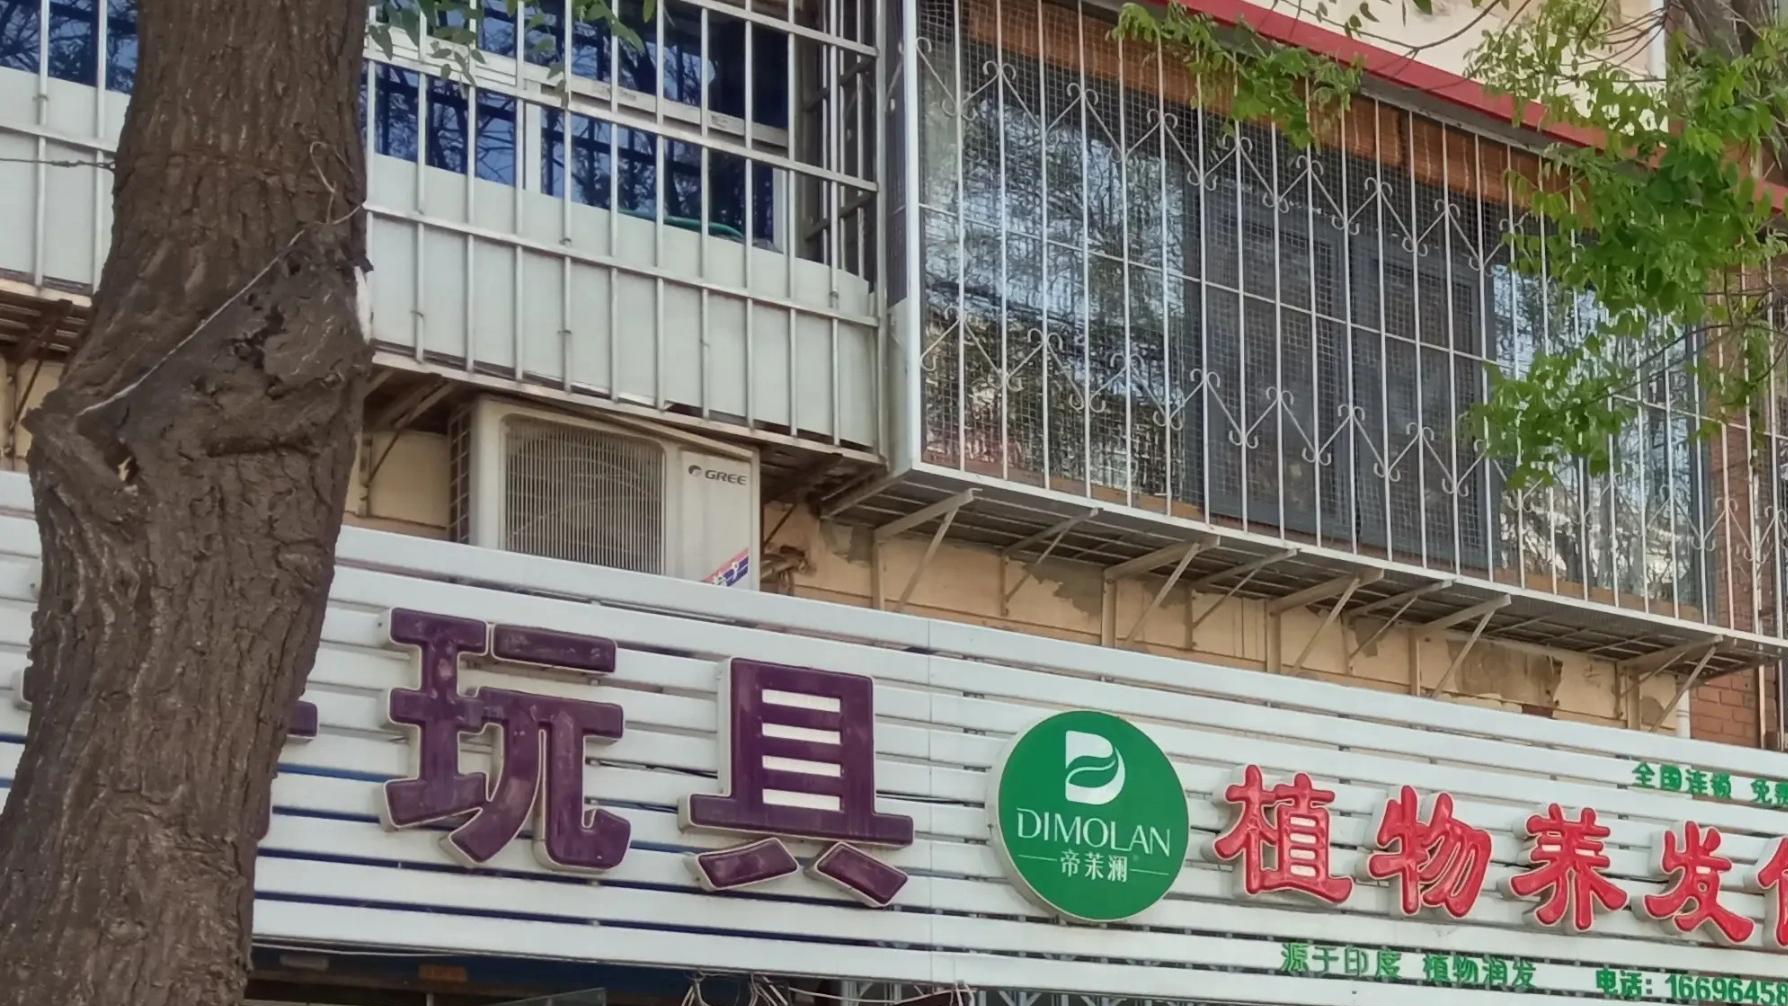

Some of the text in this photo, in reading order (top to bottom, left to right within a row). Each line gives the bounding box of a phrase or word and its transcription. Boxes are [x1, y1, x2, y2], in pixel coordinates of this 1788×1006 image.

[705, 468, 748, 486] GREE
[1633, 761, 1732, 800] 全国连锁
[1016, 807, 1172, 858] DIMOLAN
[1280, 940, 1402, 982] 源于印度
[1422, 951, 1537, 991] 植物润发
